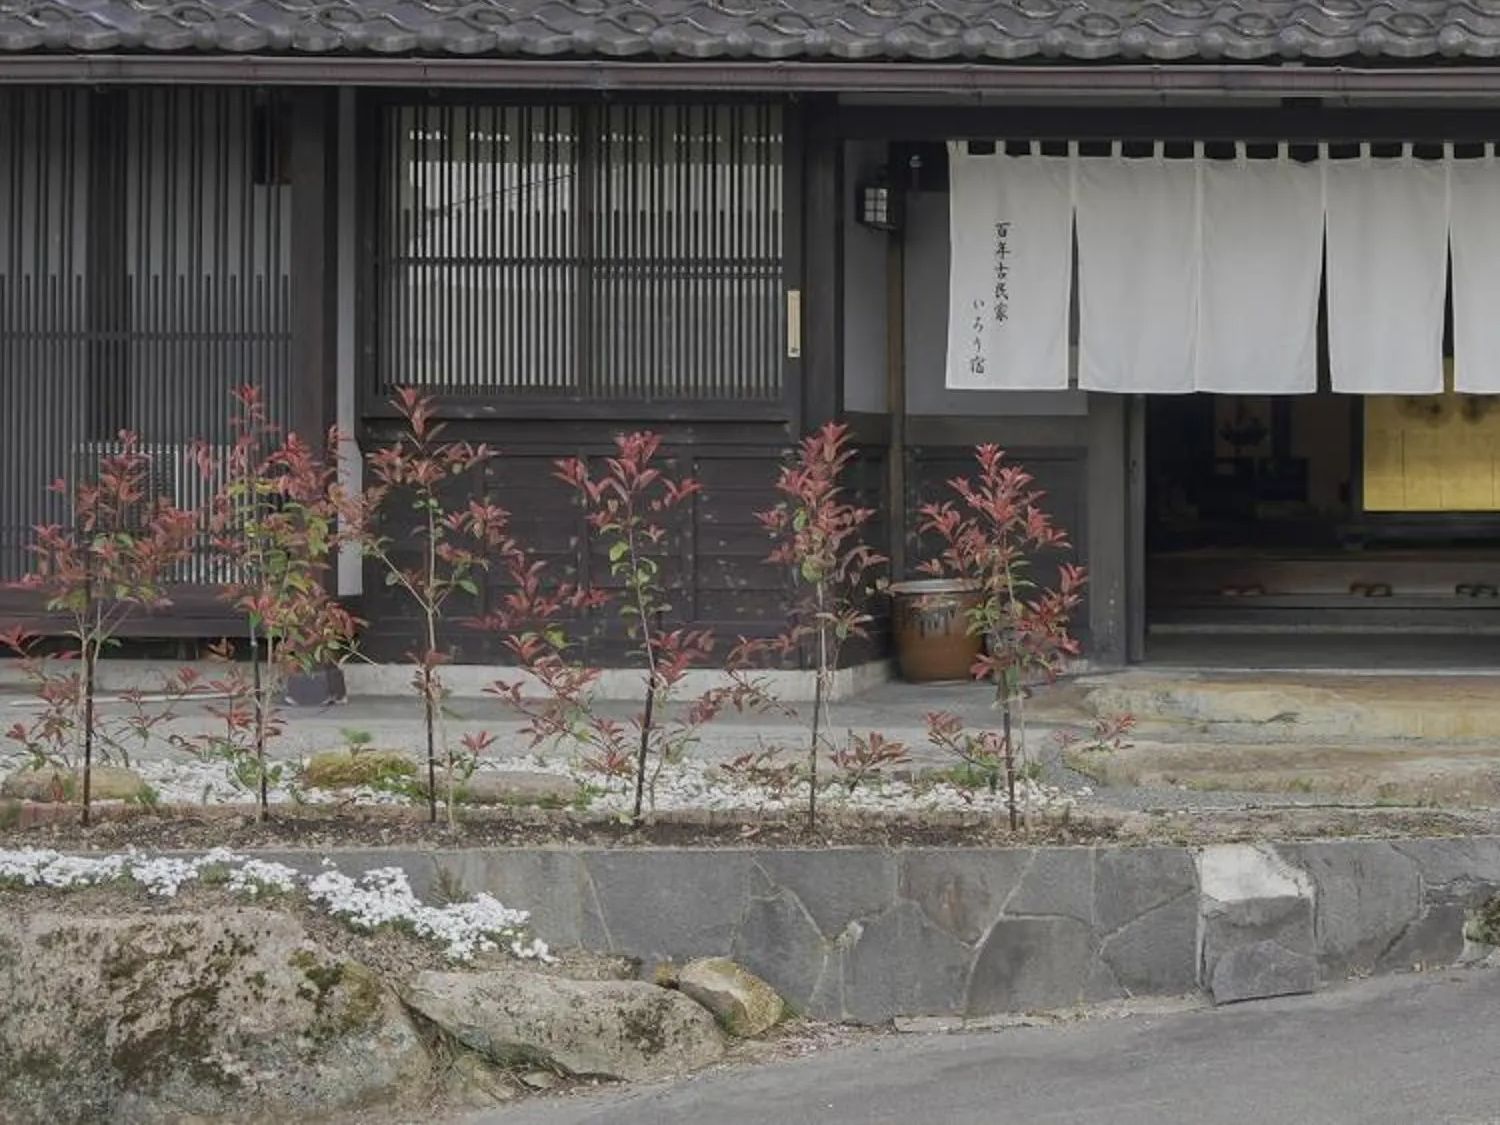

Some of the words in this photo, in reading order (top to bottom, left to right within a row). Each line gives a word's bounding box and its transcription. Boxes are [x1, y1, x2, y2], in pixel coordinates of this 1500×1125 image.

[995, 221, 1011, 322] 百年古民家
